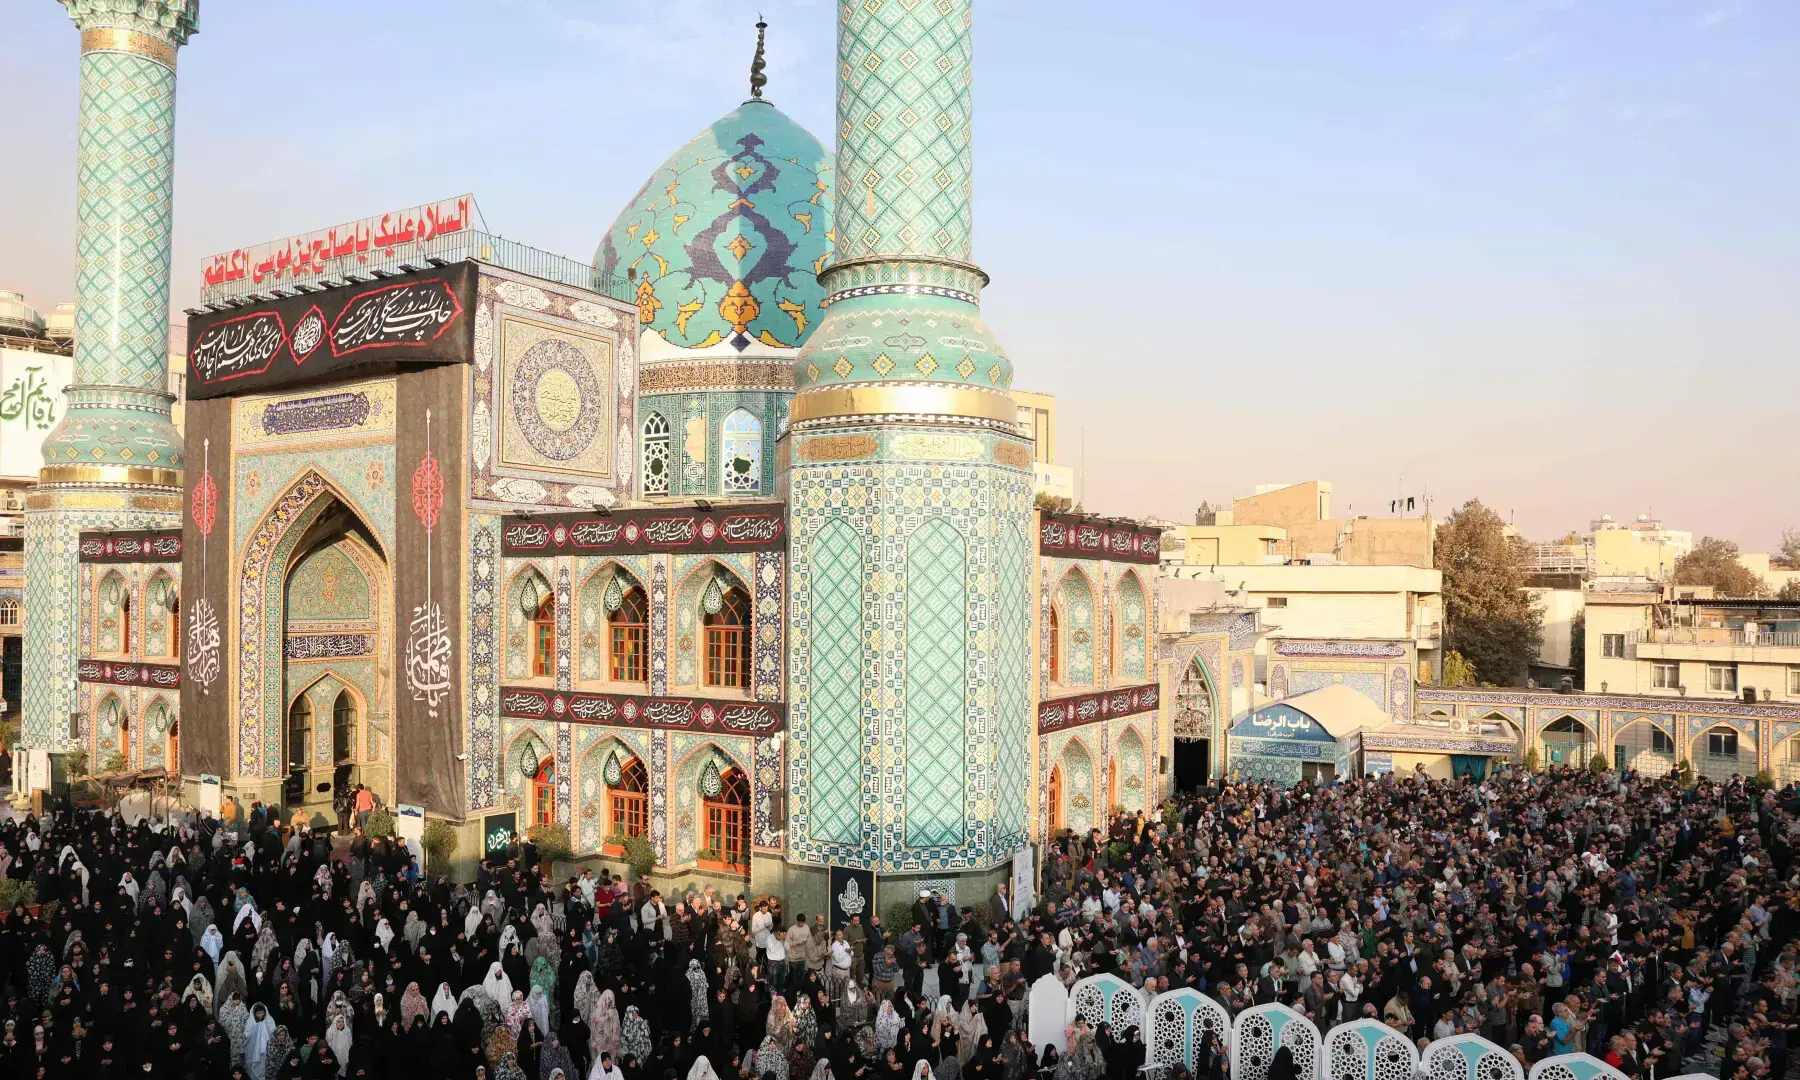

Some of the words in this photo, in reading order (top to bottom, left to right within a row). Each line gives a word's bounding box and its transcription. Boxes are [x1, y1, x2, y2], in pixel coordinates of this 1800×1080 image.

[416, 199, 471, 250] السلام
[1252, 713, 1287, 731] الرضا
[1287, 716, 1311, 733] باب
